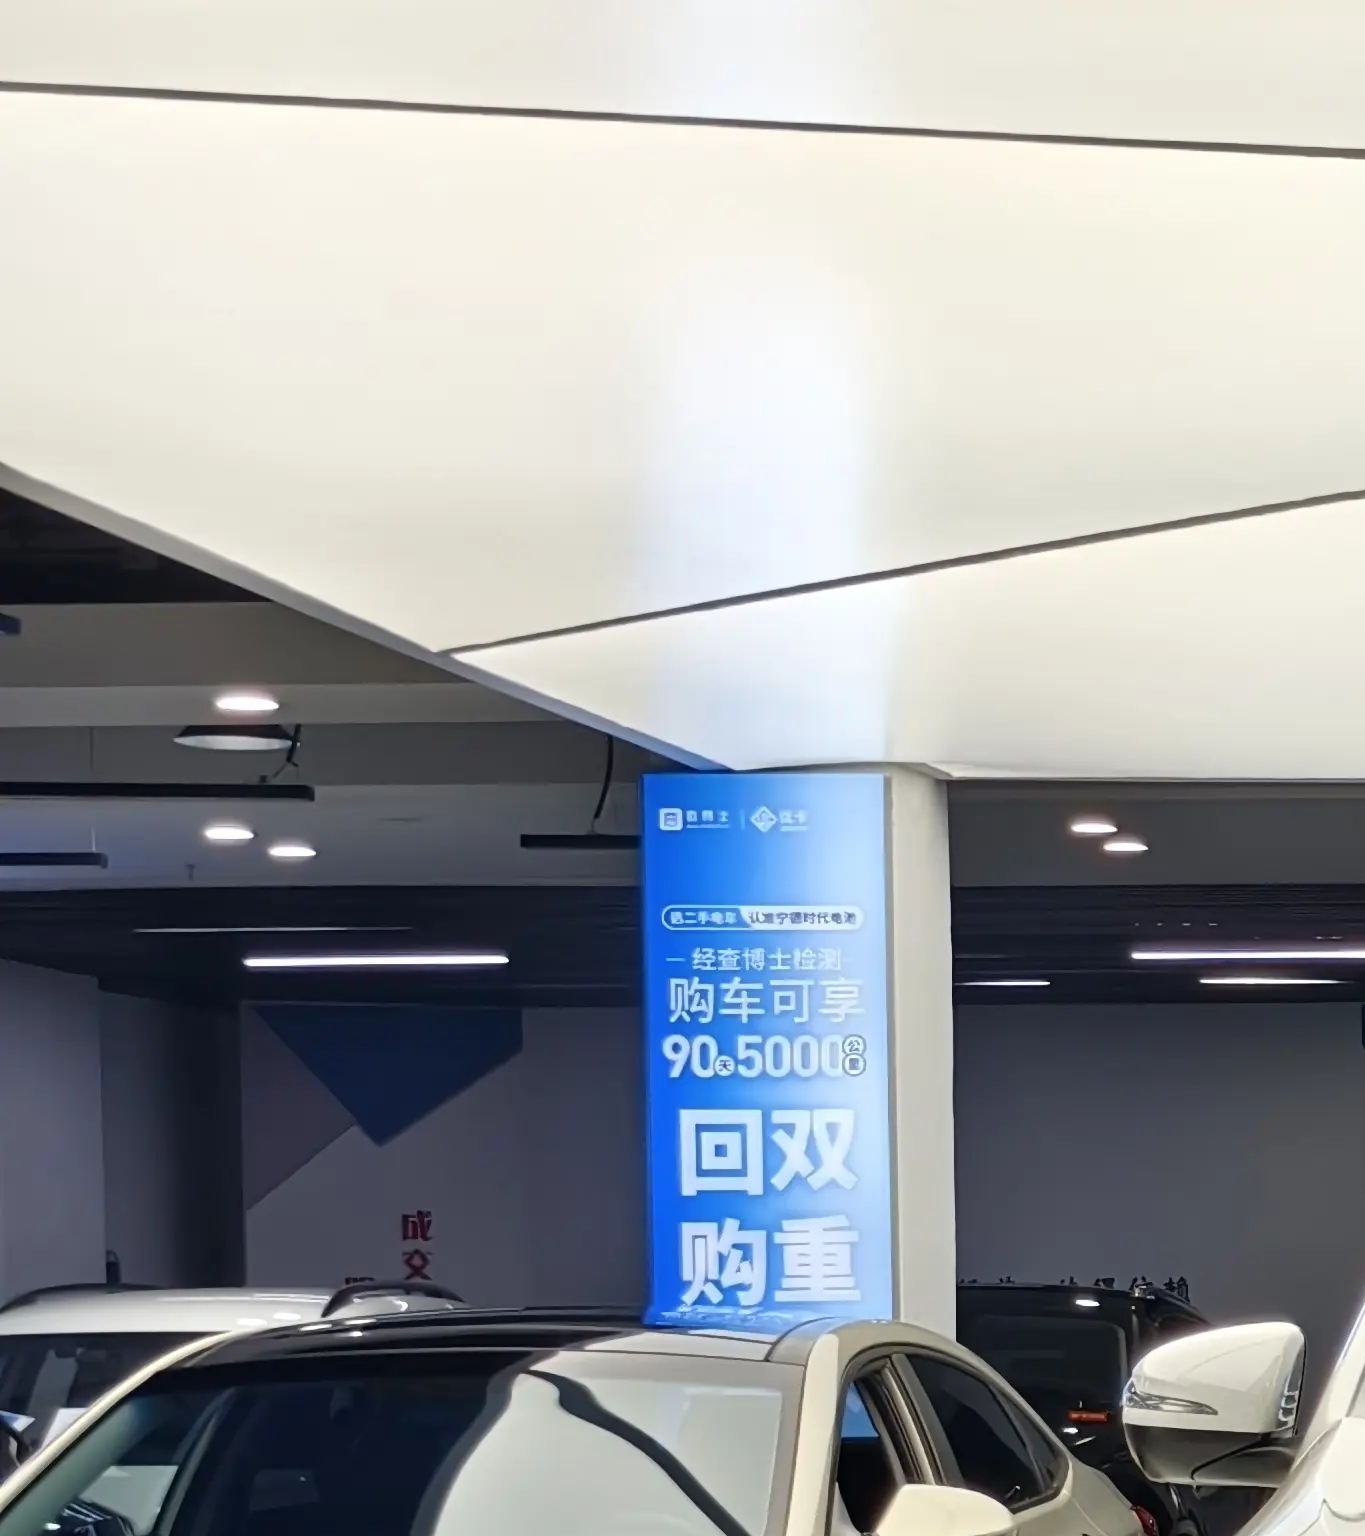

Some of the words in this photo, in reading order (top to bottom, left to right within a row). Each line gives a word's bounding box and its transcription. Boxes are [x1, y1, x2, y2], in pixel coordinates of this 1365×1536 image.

[747, 911, 857, 926] 认宁德时代电池
[691, 947, 842, 972] 经查博士检测
[668, 977, 865, 1024] 购车可享
